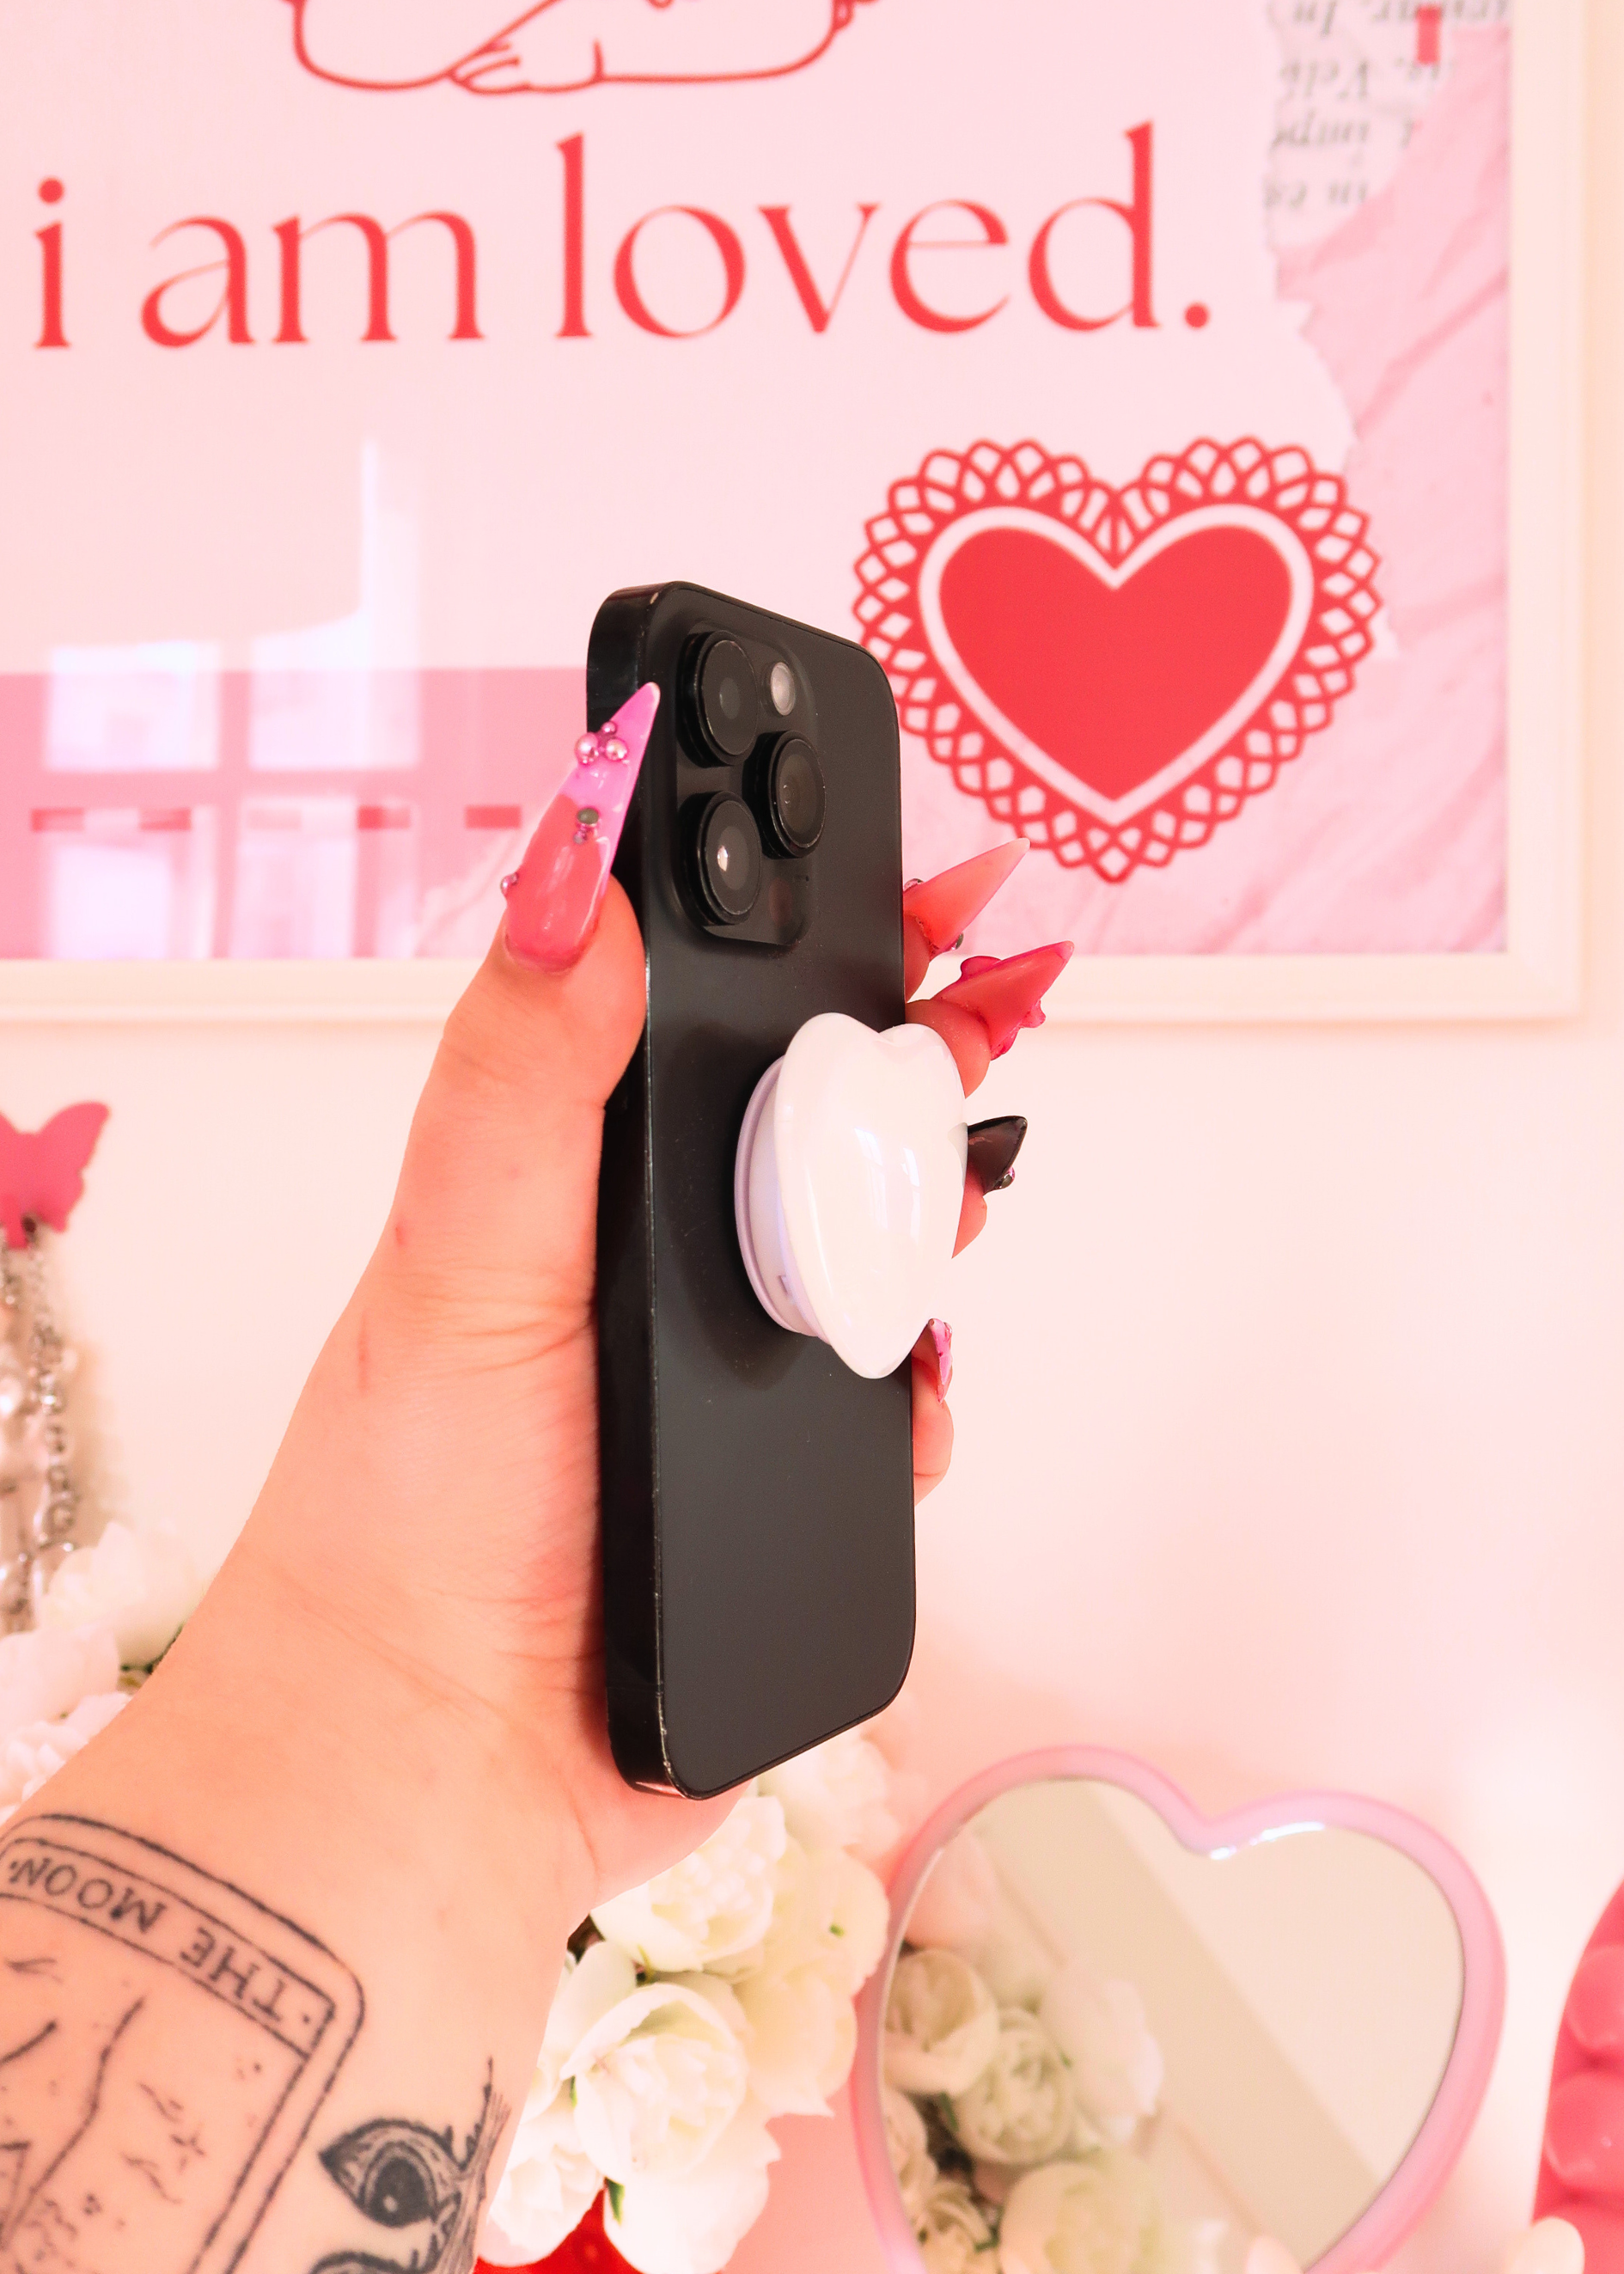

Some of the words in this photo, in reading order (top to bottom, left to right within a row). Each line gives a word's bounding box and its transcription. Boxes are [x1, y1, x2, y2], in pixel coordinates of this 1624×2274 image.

[34, 177, 71, 349] i
[140, 211, 485, 348] am
[554, 121, 1210, 339] loved.
[179, 1927, 288, 2023] THE
